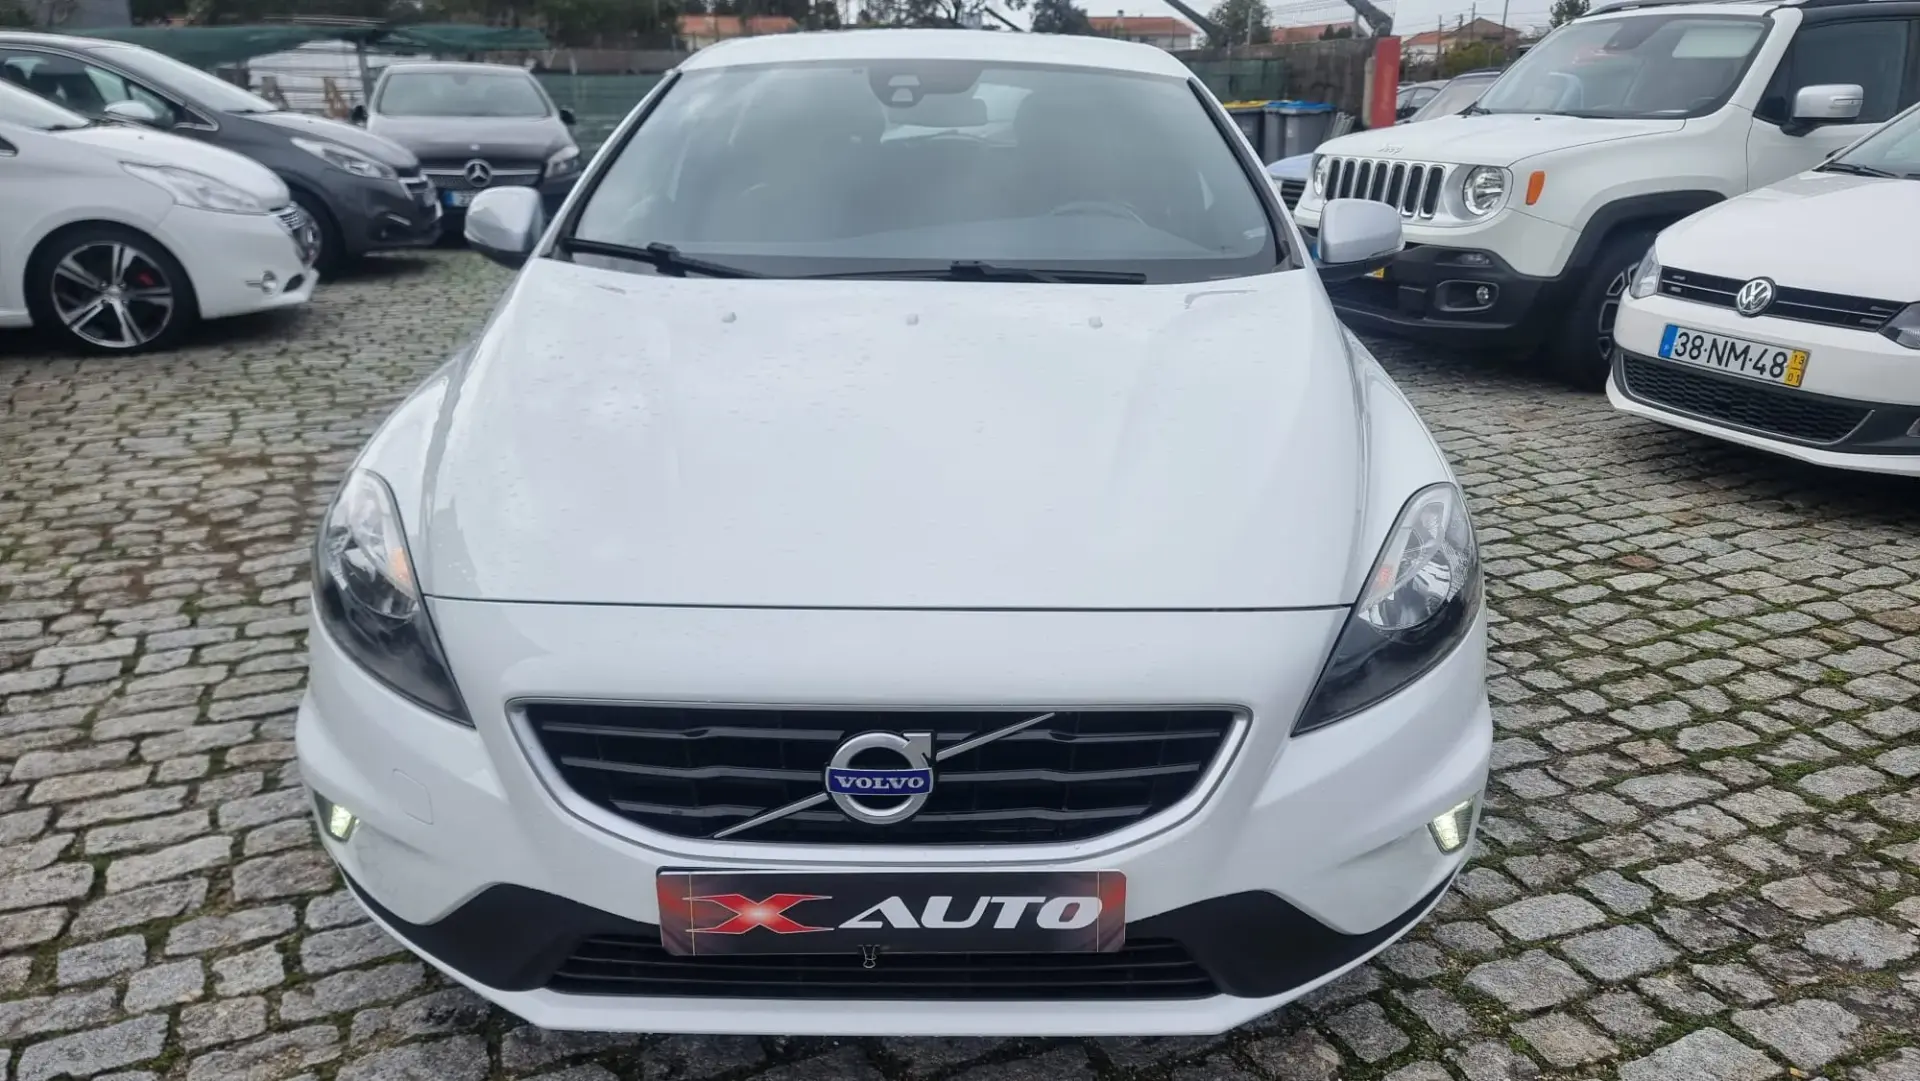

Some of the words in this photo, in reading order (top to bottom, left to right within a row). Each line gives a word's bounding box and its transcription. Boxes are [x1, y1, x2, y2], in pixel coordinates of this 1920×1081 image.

[1793, 353, 1805, 366] 13
[1787, 372, 1800, 383] 01
[834, 775, 925, 790] VOLVO
[682, 893, 834, 934] X
[838, 895, 1103, 930] AUTO
